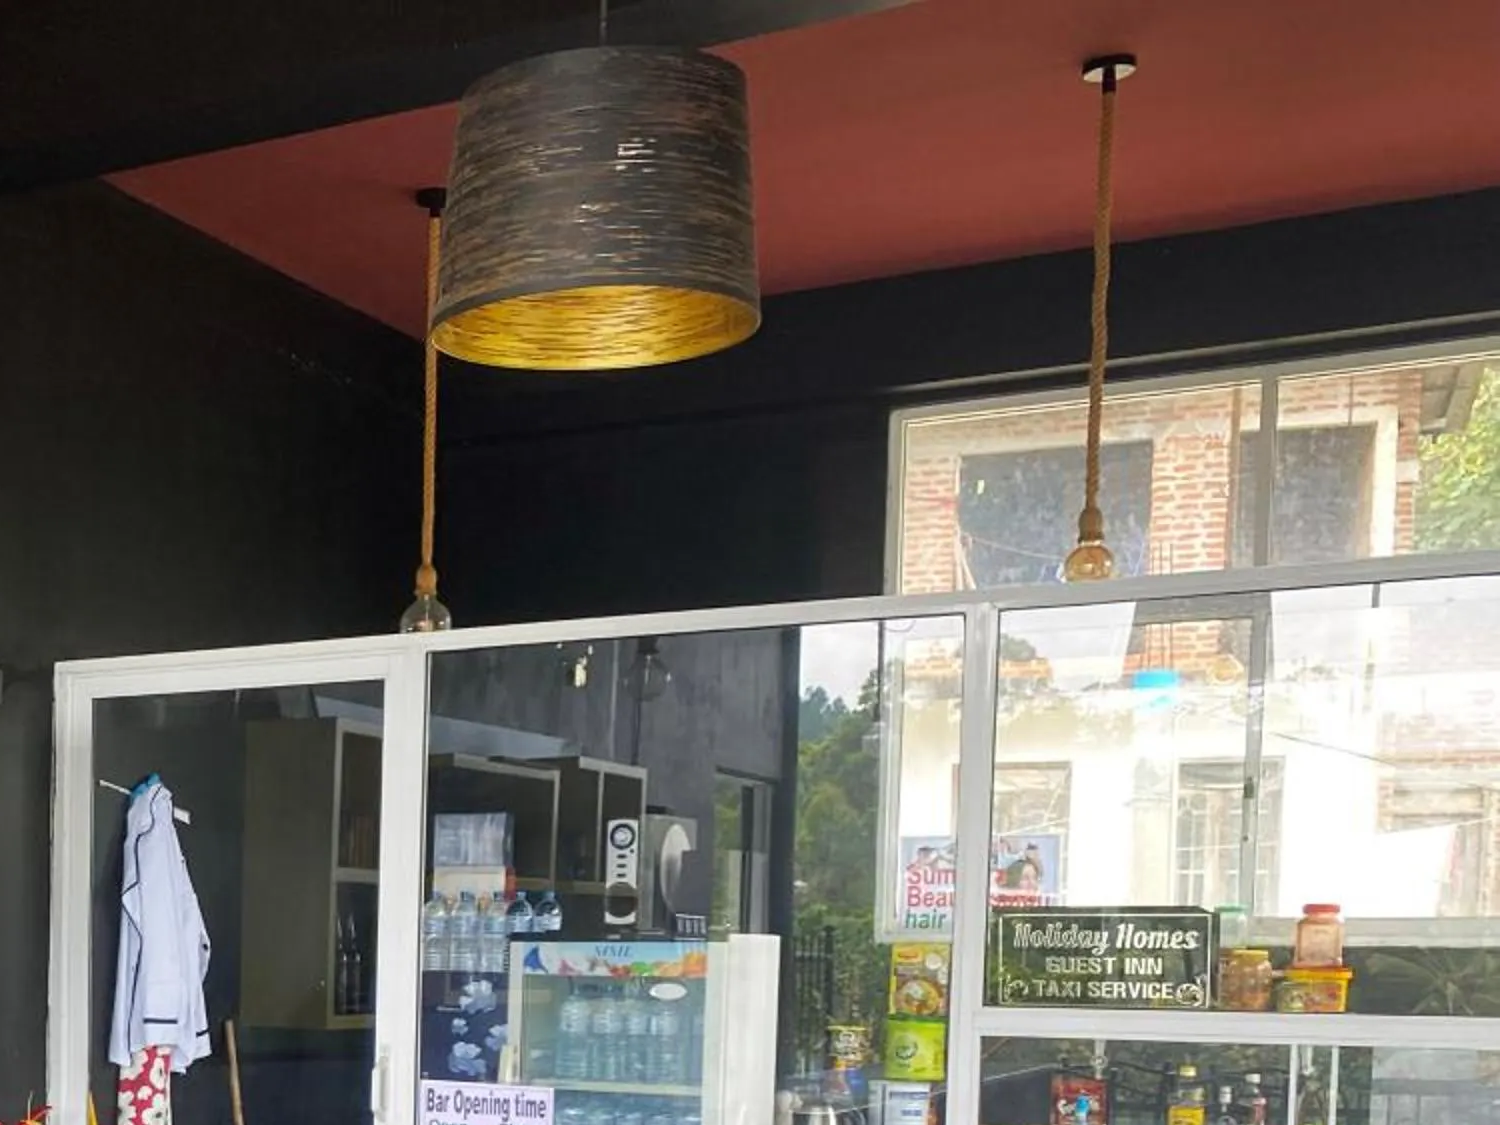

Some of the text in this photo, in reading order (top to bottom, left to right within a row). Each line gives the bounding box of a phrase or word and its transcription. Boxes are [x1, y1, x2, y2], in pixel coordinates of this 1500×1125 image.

[905, 908, 947, 929] hair
[1012, 921, 1200, 955] Holiday Homes
[1045, 957, 1163, 975] GUEST INN
[1032, 979, 1175, 999] TAXI SERVICE
[426, 1088, 547, 1122] Bar Opening time
